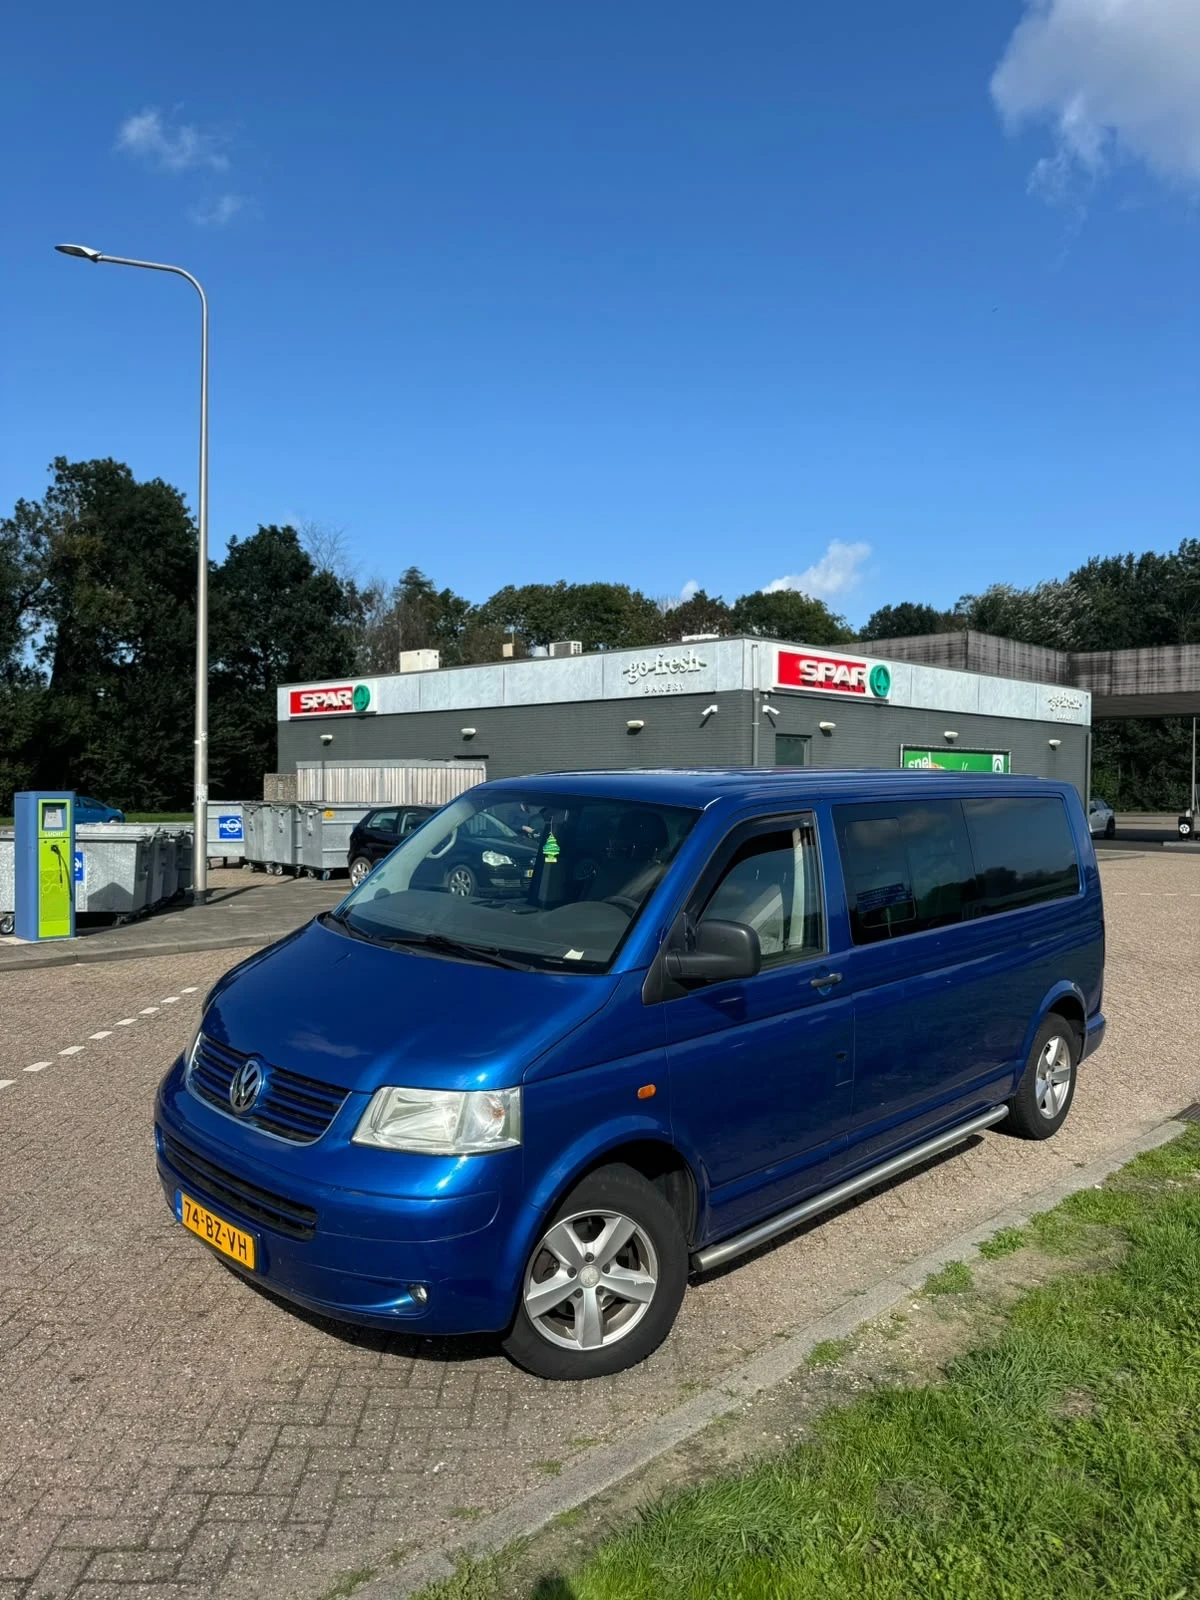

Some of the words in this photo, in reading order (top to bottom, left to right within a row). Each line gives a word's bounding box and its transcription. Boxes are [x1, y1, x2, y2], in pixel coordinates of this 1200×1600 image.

[799, 659, 866, 688] SPAR
[300, 690, 352, 710] SPAR
[184, 1200, 248, 1261] 74-BZ-VH
